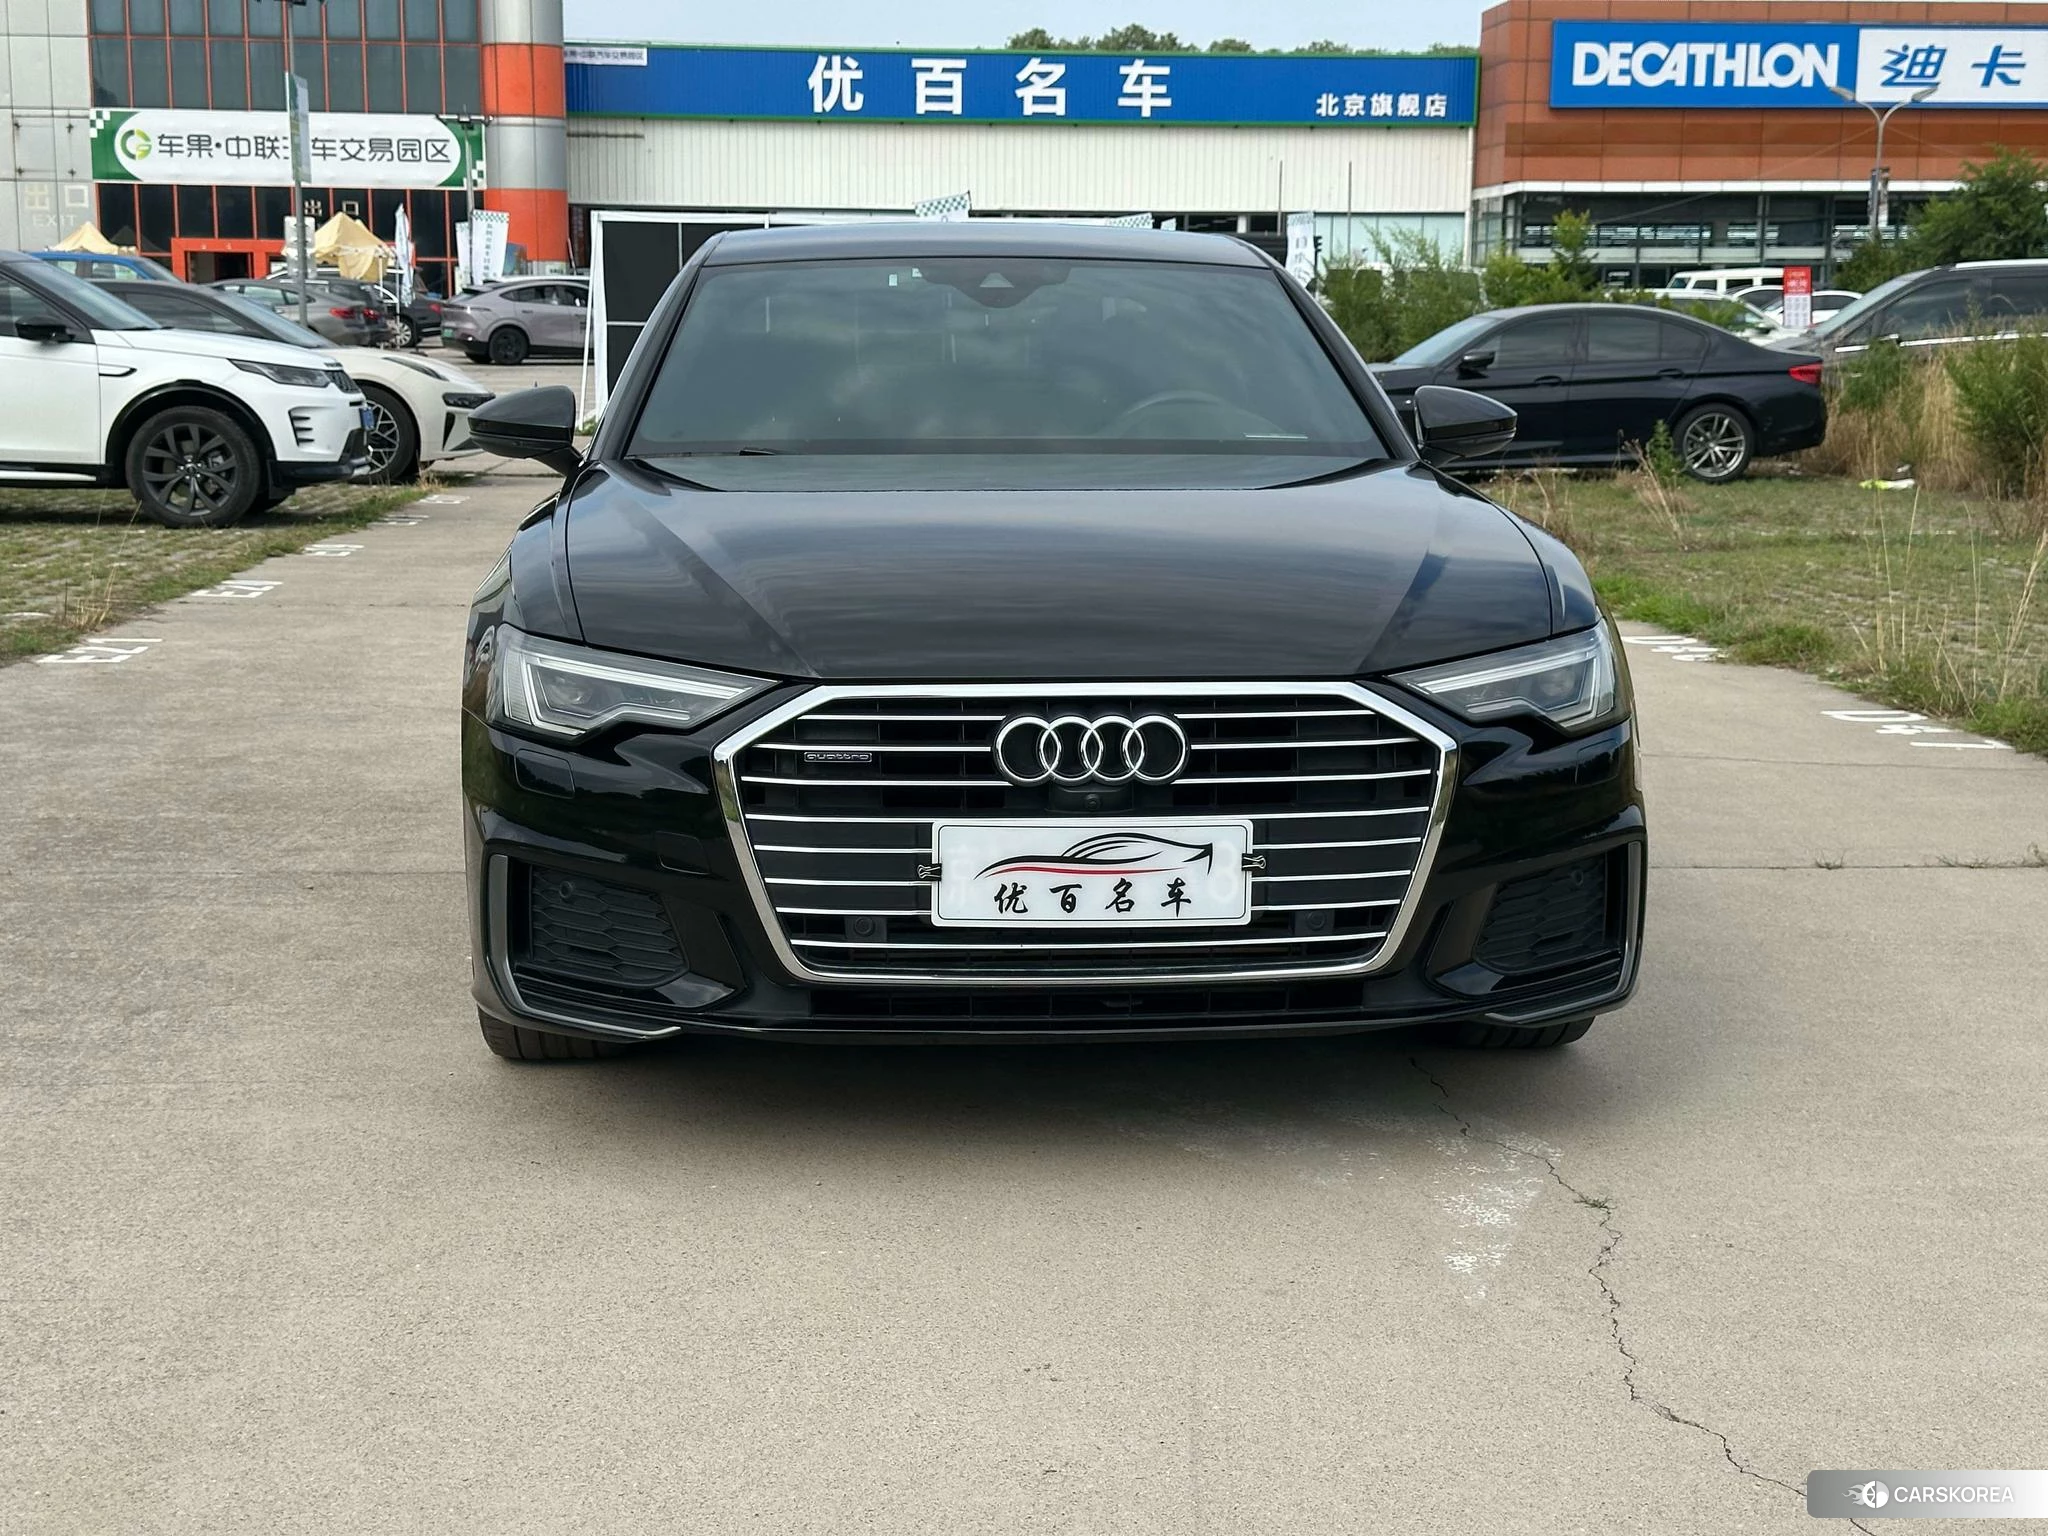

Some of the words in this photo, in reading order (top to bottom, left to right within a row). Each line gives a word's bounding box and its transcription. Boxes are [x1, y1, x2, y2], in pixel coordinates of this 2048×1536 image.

[1572, 42, 1840, 87] DECATHLON
[1879, 44, 2027, 87] 迪卡
[807, 54, 1173, 118] 优百名车
[1315, 92, 1448, 118] 北京旗舰店
[157, 133, 452, 163] 车果·中联车交易园区
[32, 213, 77, 227] EXIT
[36, 637, 163, 663] E21
[806, 753, 870, 761] quattro
[993, 876, 1192, 918] 优百名车
